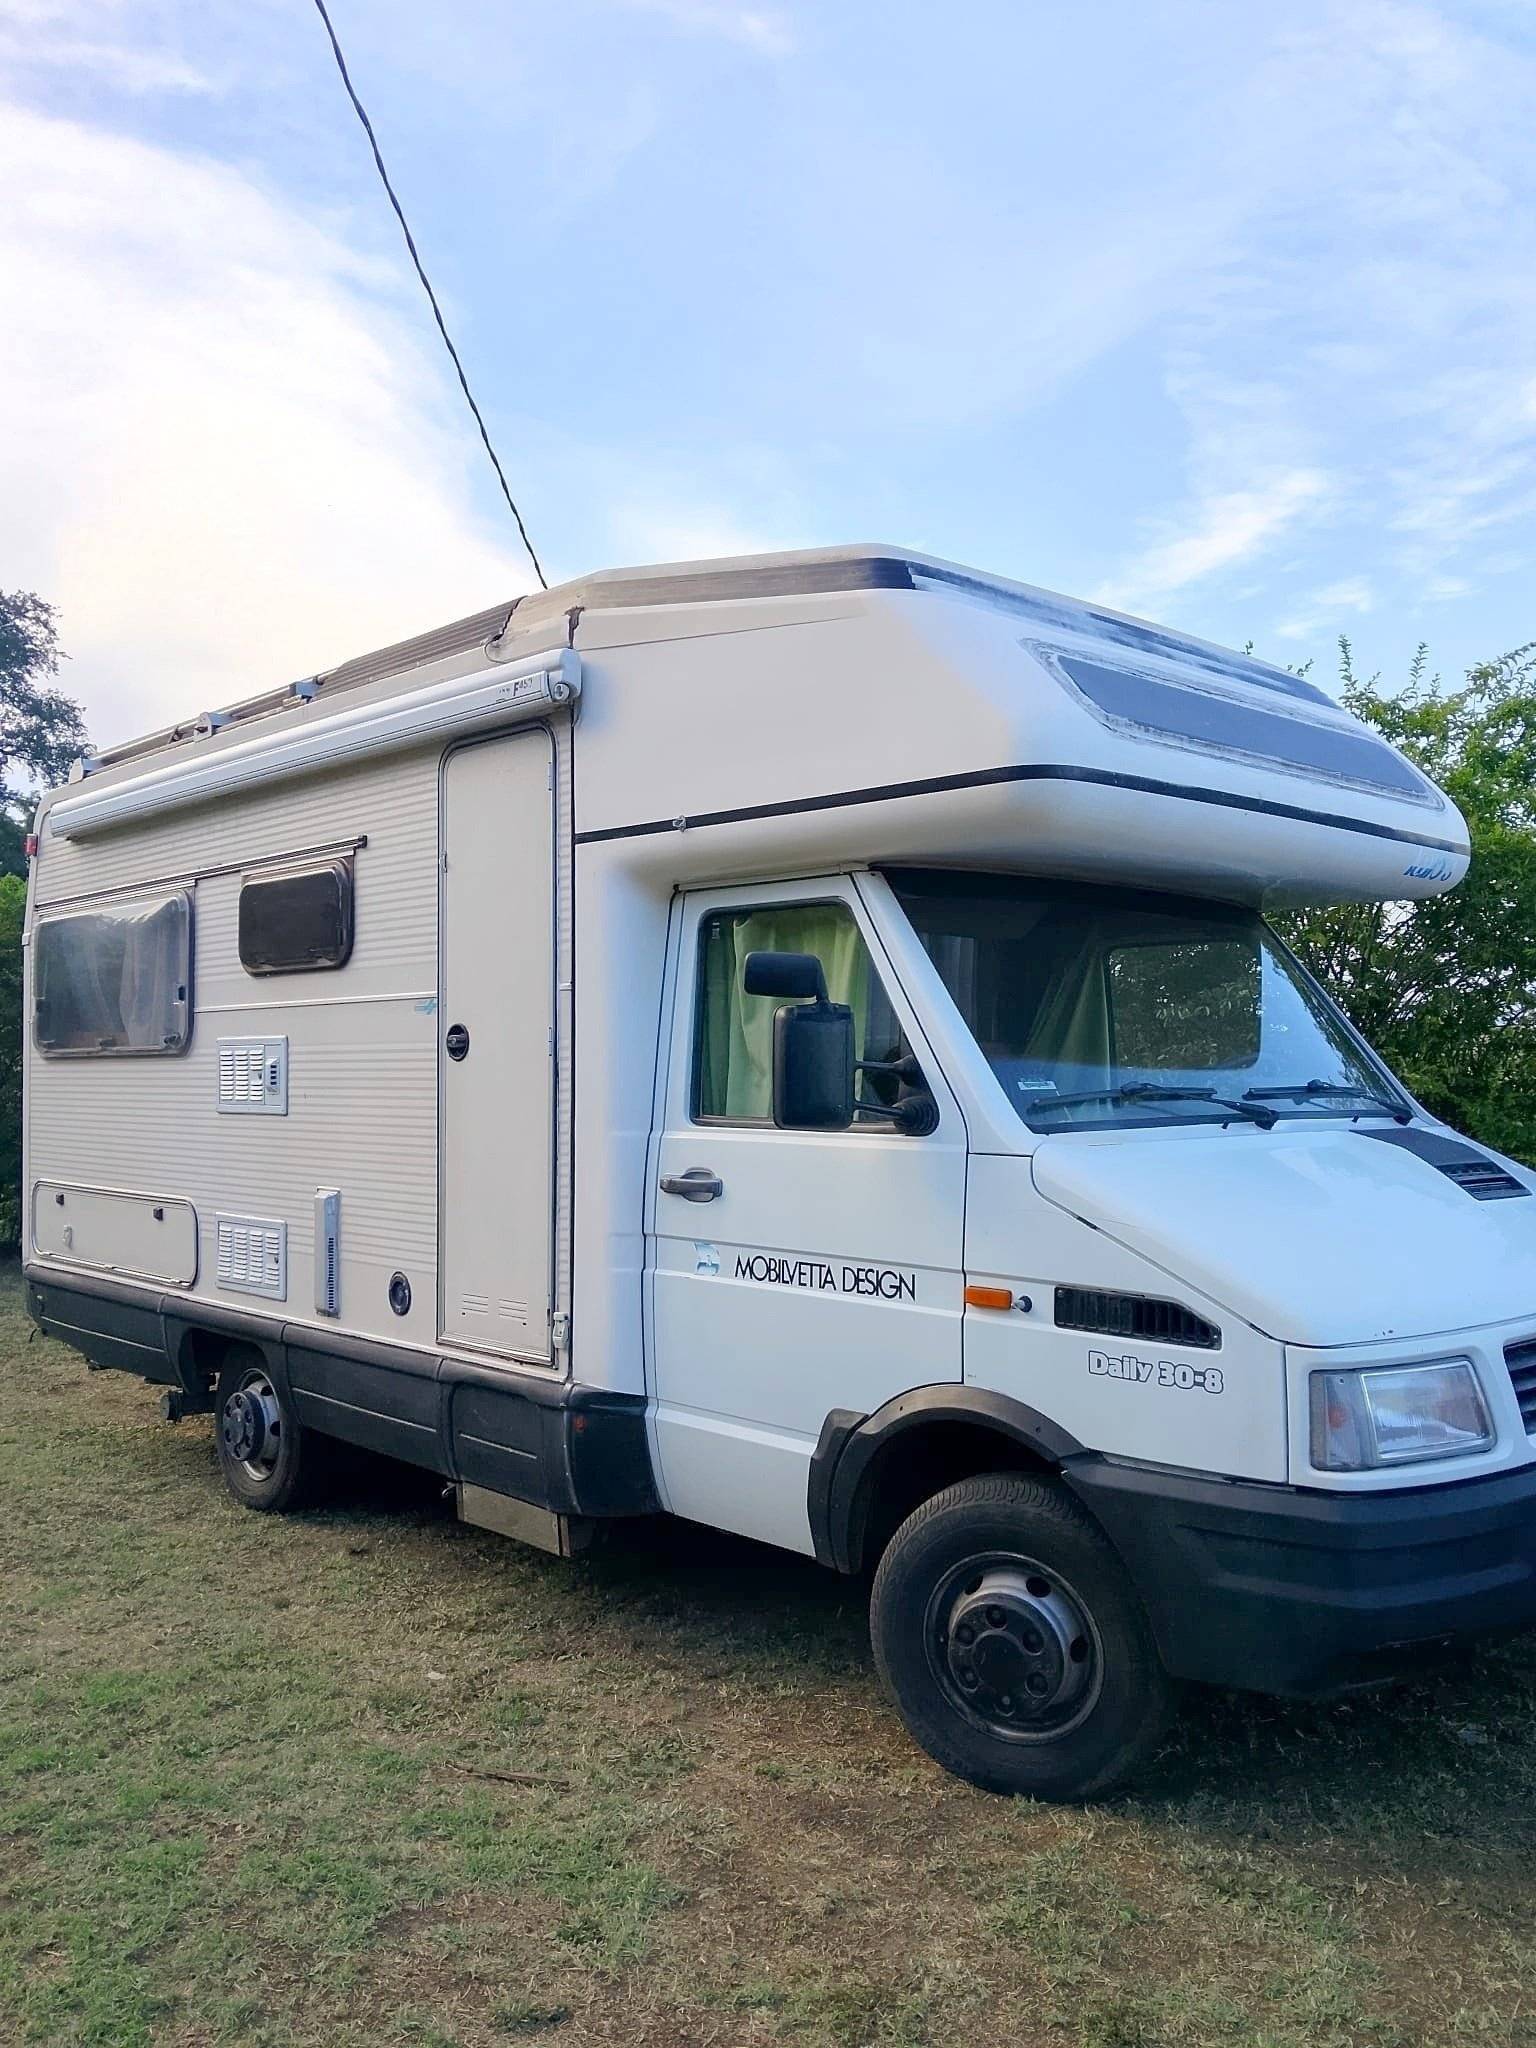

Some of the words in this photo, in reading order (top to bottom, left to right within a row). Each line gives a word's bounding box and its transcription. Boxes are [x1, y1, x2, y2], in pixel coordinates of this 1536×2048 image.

[735, 1254, 836, 1291] MOBILVETTA
[842, 1266, 916, 1301] DESIGN
[1088, 1350, 1153, 1382] Daily
[1158, 1360, 1224, 1394] 30-8
